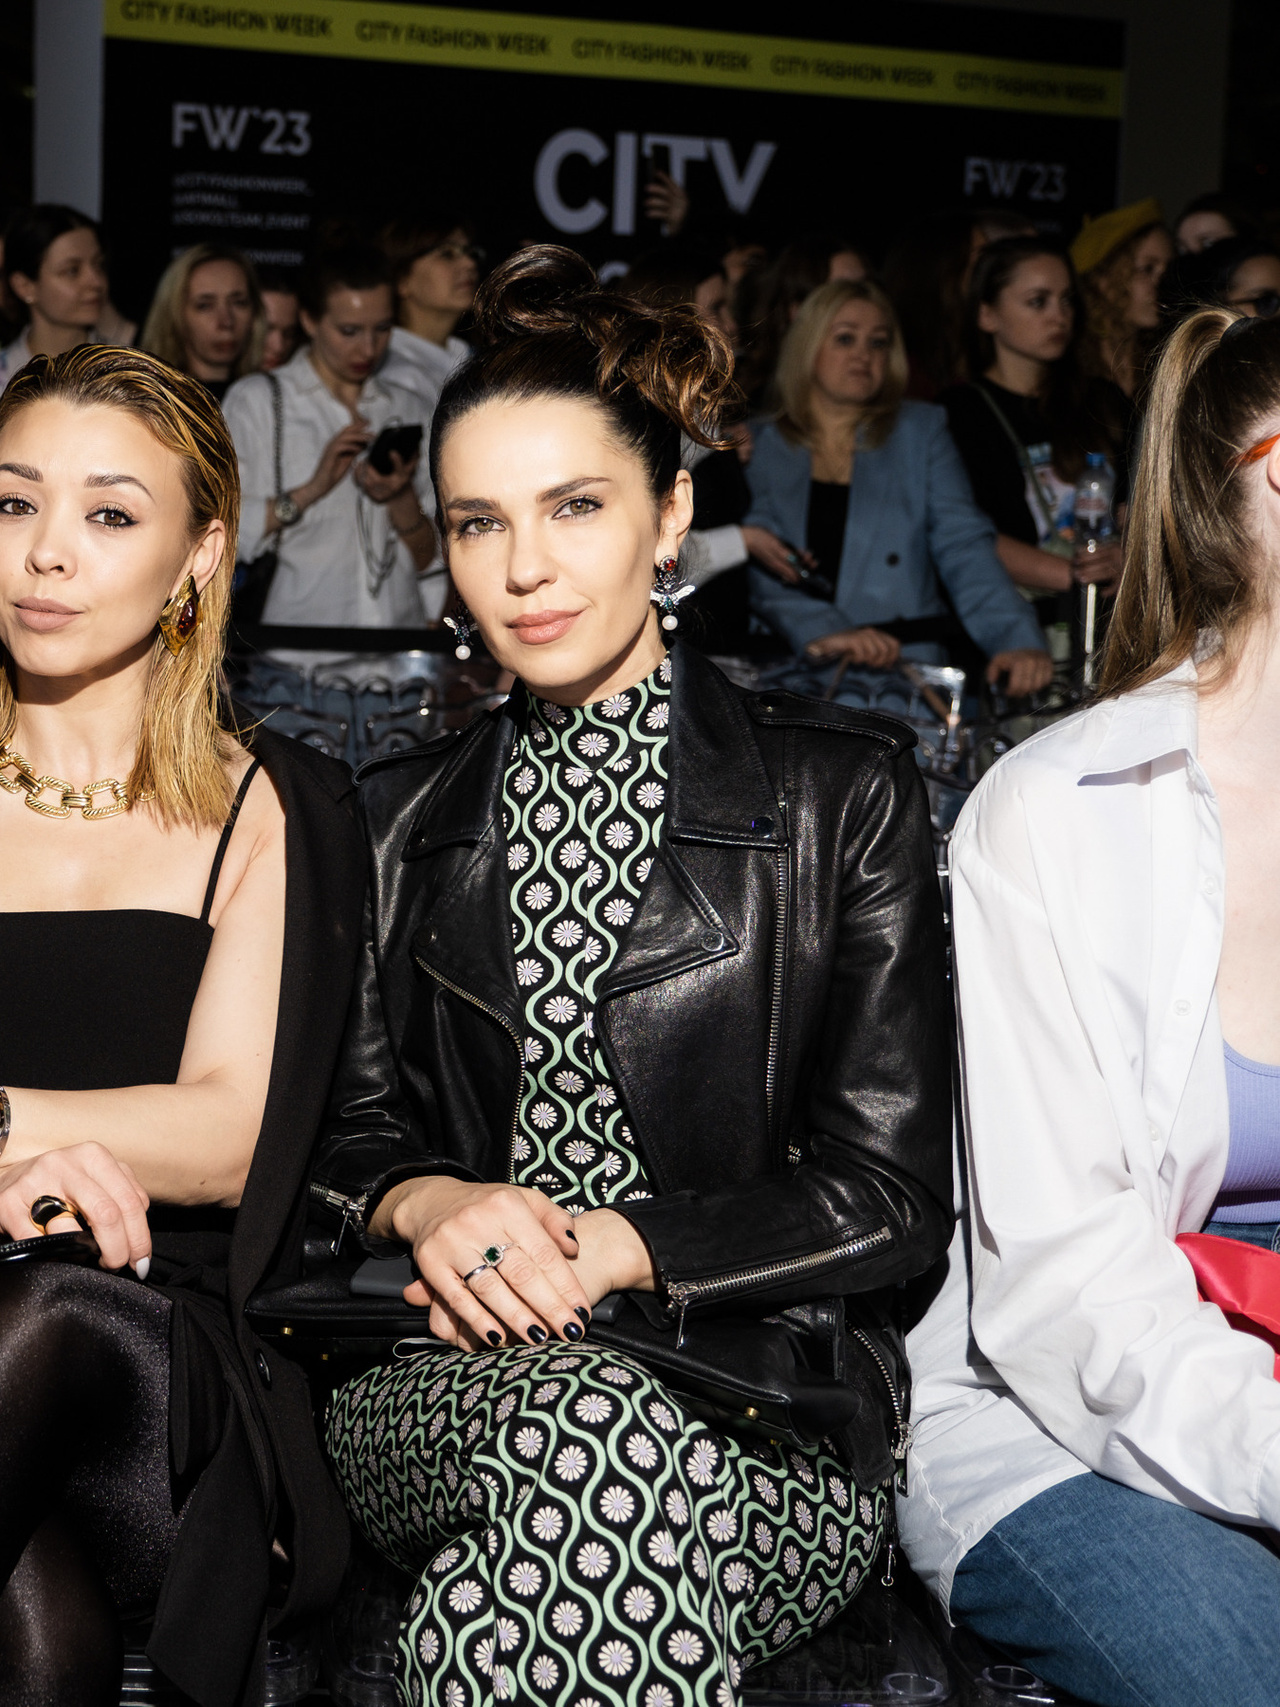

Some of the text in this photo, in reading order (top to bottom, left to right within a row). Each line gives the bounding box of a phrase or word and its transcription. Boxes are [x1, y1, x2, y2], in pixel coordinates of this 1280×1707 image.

[120, 0, 332, 38] CITY FASHION WEEK
[355, 19, 551, 55] CITY FASHION WEEK
[571, 37, 753, 72] CITY FASHION WEEK
[769, 54, 936, 88] CITY FASHION WEEK
[953, 70, 1107, 104] CITY FASHION WEEK
[533, 127, 778, 237] CITY
